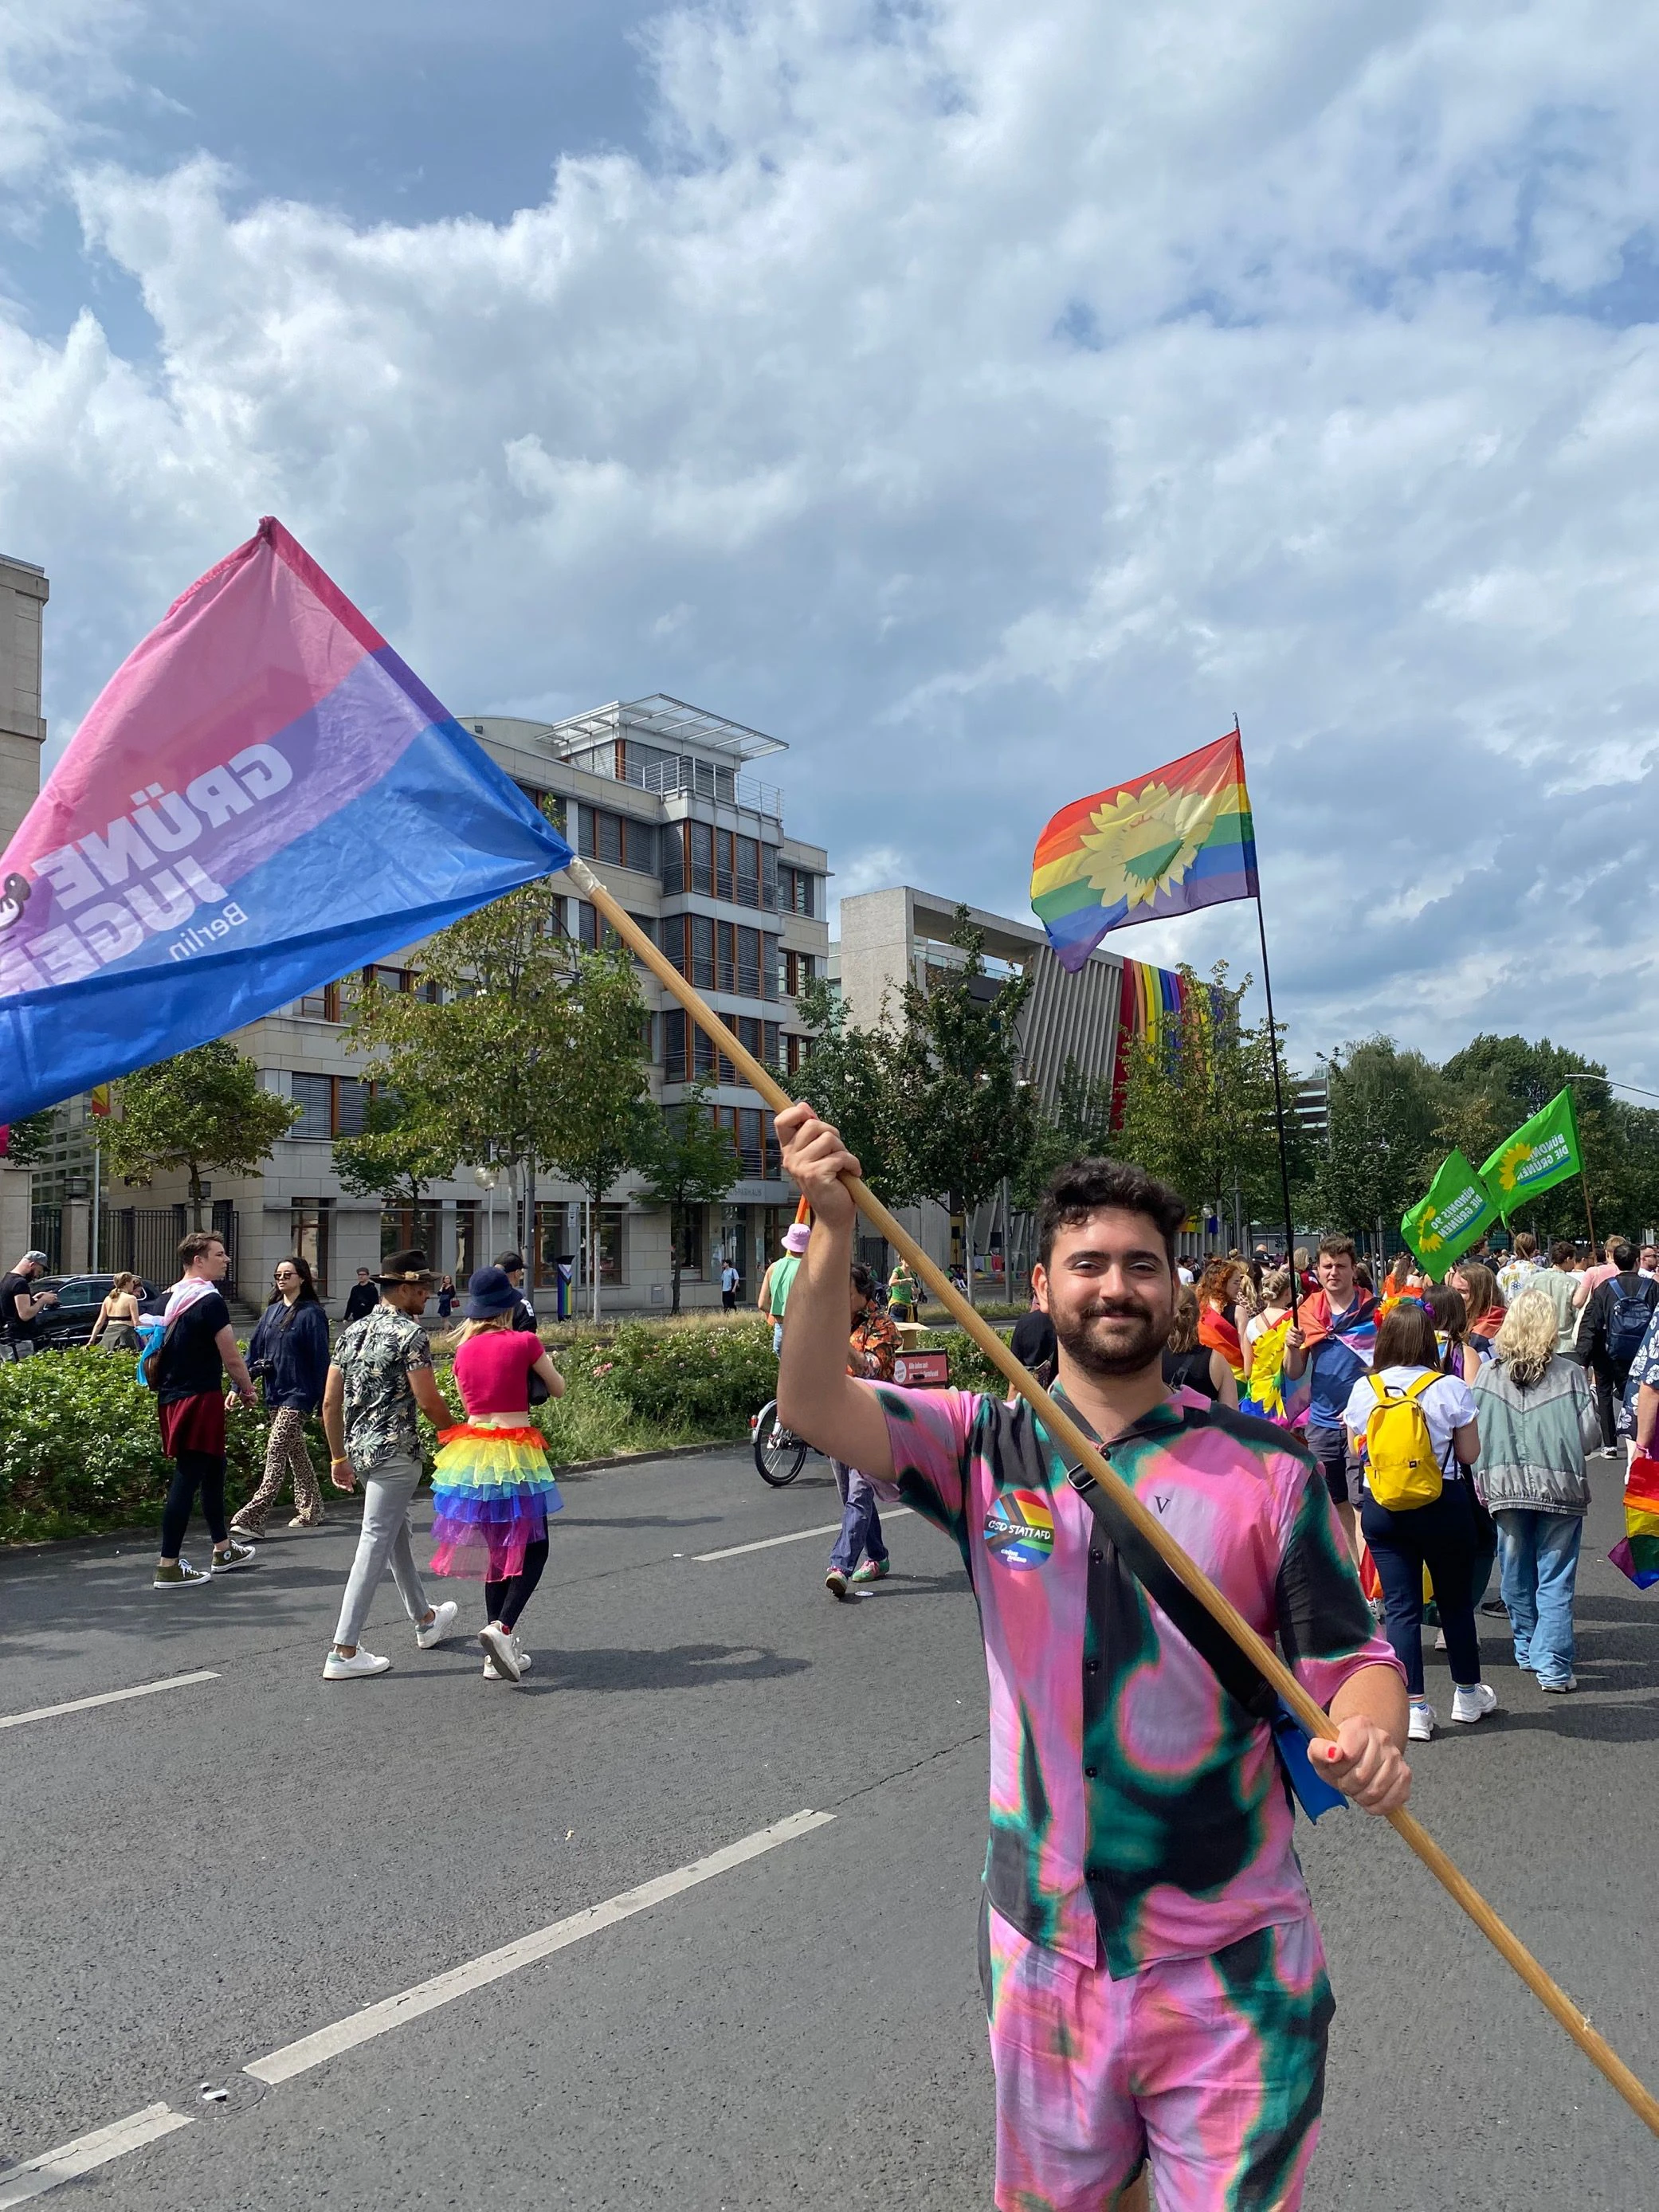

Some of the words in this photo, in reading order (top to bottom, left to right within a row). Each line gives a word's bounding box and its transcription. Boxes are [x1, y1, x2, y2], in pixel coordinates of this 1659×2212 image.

[1154, 1495, 1171, 1514] V
[988, 1520, 1007, 1532] CSD
[1009, 1525, 1035, 1537] STATT
[1034, 1529, 1051, 1539] AFD
